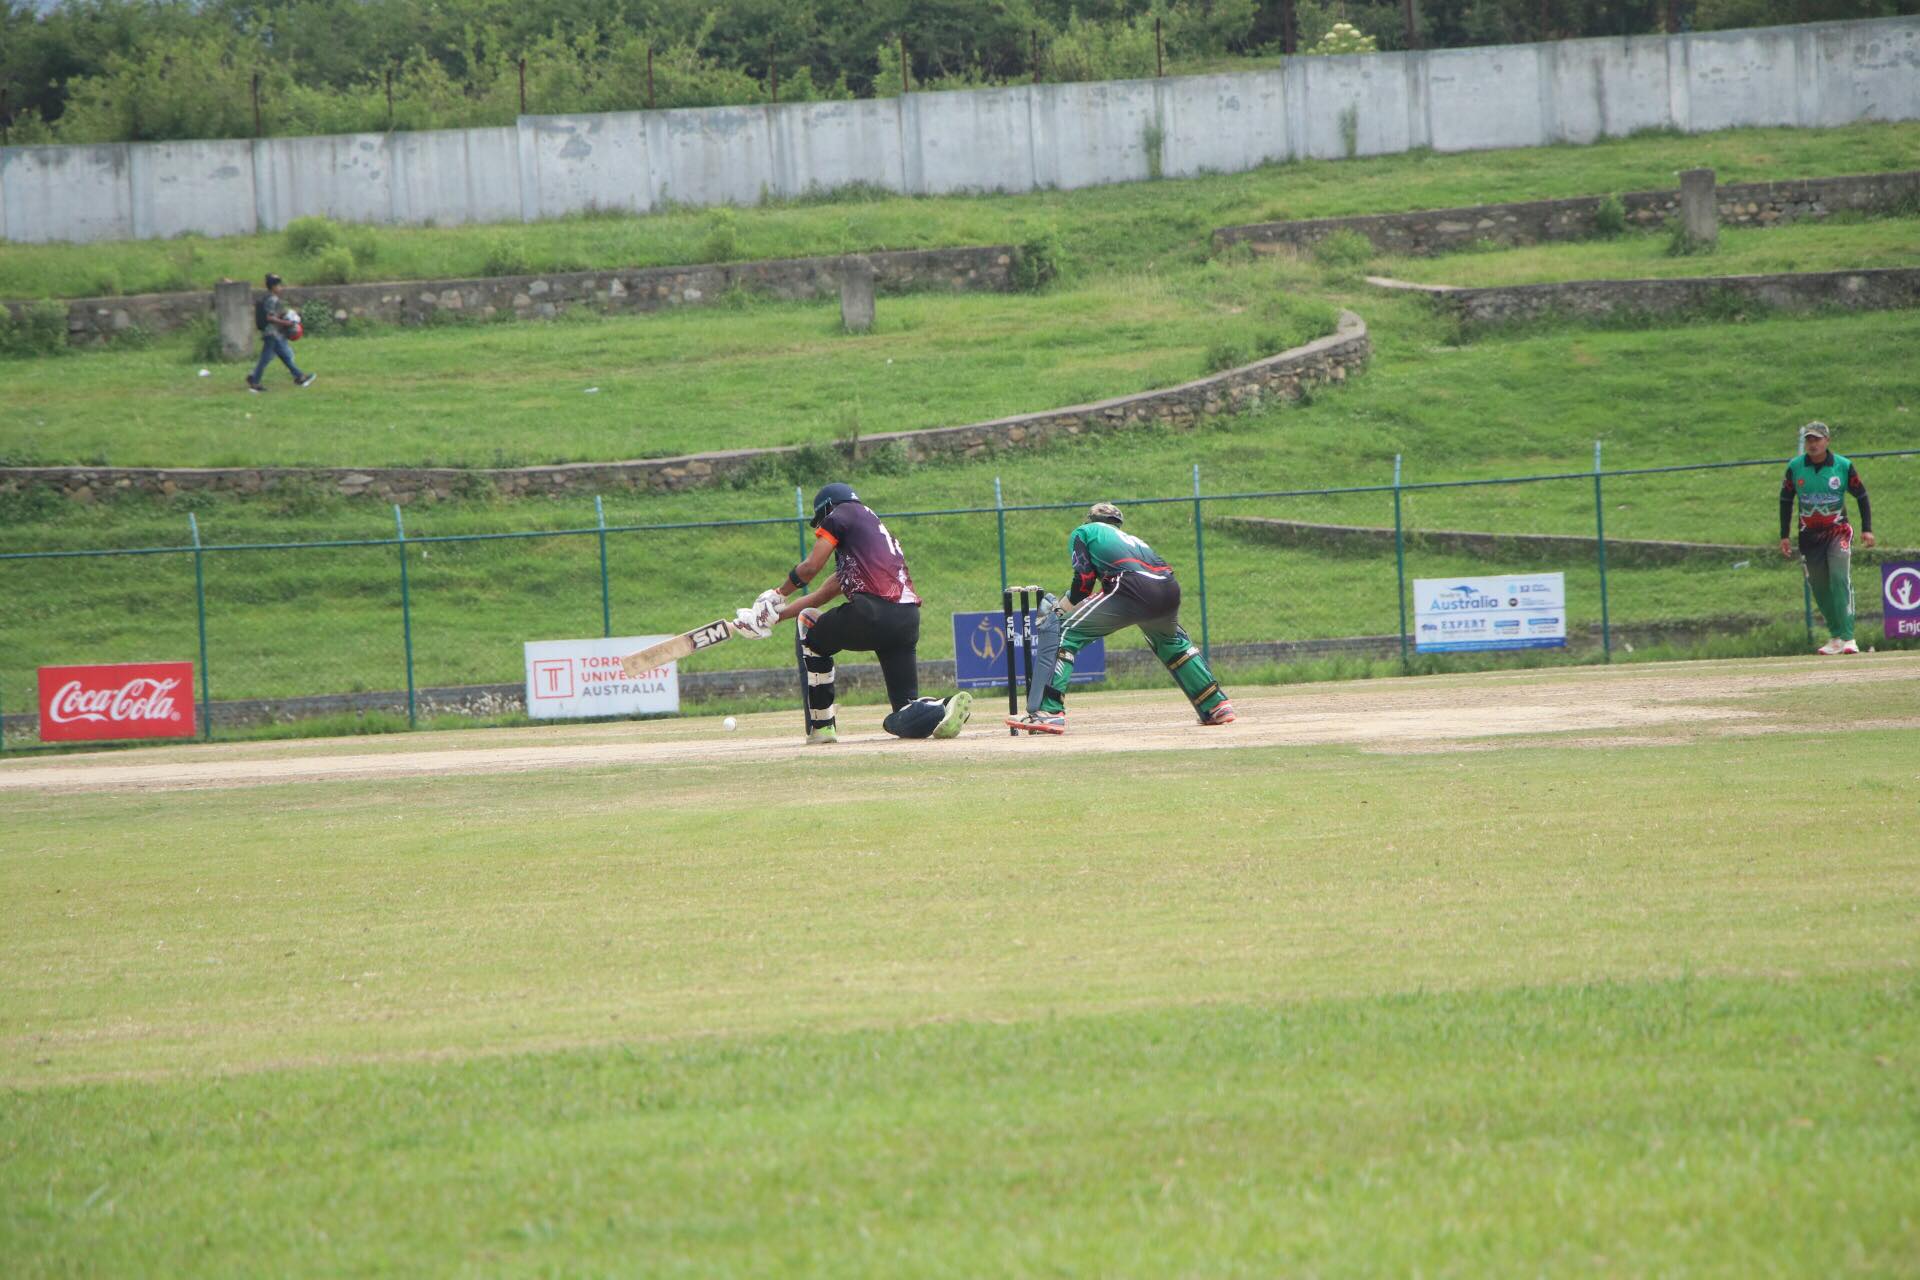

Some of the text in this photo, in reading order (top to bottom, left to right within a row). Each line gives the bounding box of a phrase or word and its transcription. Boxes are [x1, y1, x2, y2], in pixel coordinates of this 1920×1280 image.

[1430, 595, 1499, 611] Australia
[693, 623, 728, 649] SM
[580, 656, 620, 668] TORR
[581, 682, 666, 697] AUSTRALIA
